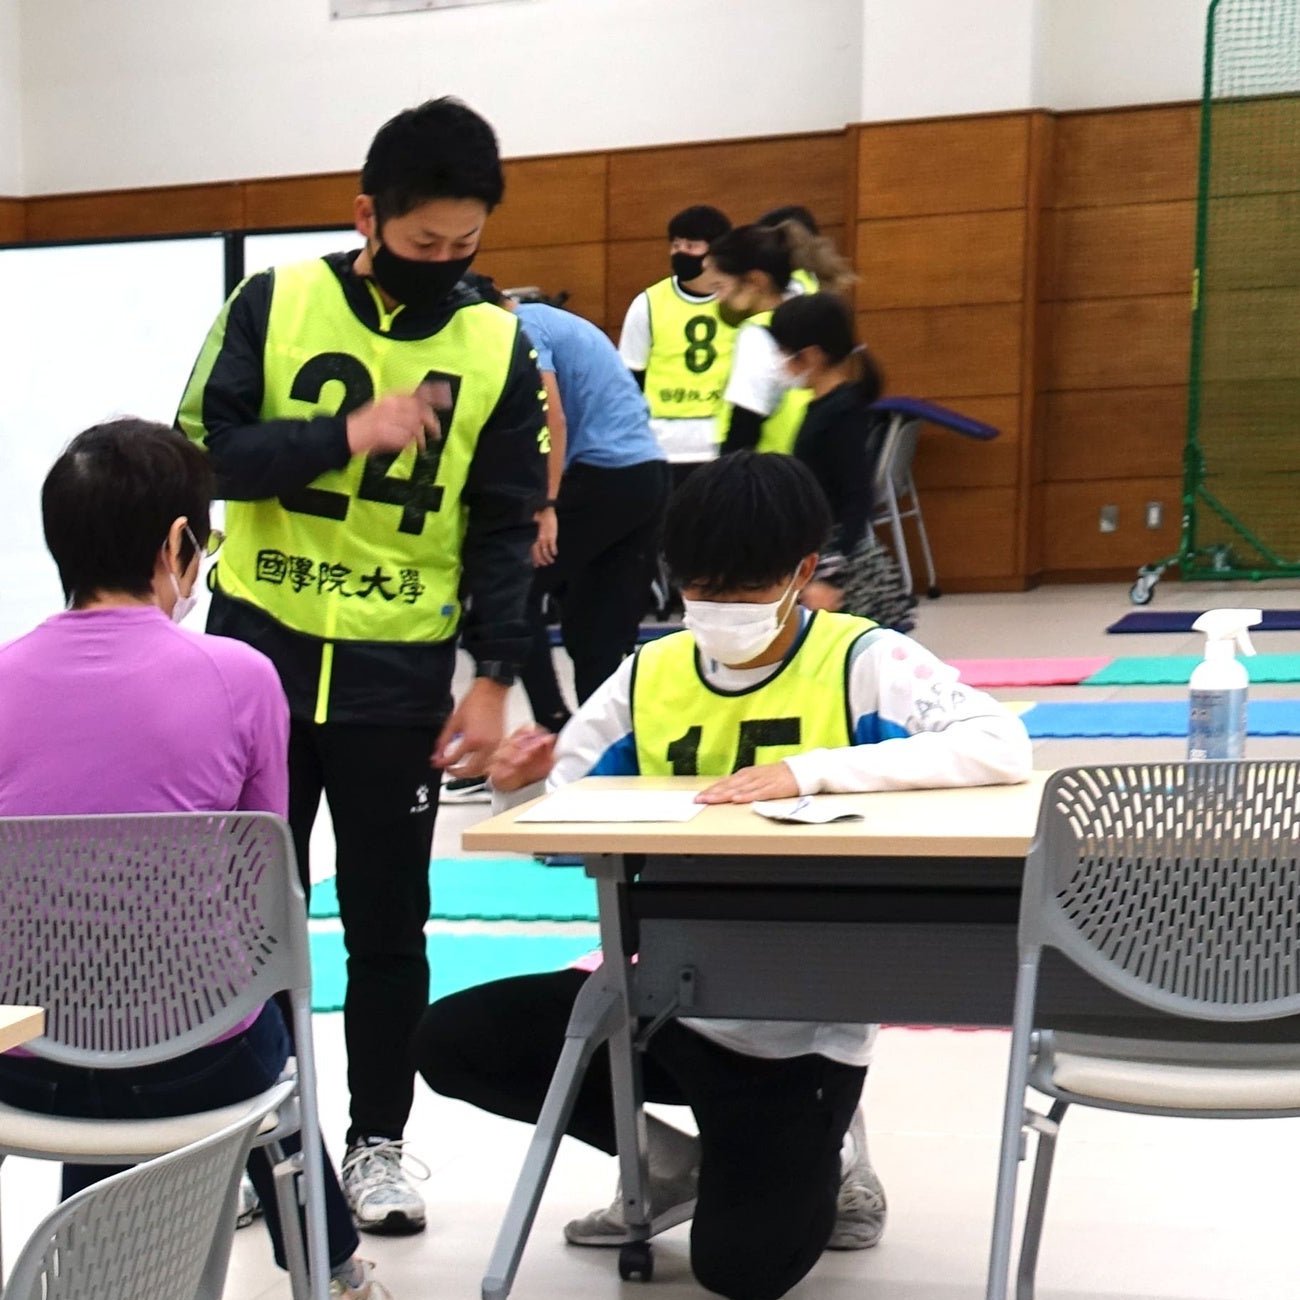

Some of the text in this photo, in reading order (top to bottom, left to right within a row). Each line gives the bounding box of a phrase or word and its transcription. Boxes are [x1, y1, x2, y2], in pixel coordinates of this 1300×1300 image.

[684, 315, 718, 374] 8
[279, 352, 463, 536] 24
[255, 548, 427, 605] 國學院大學
